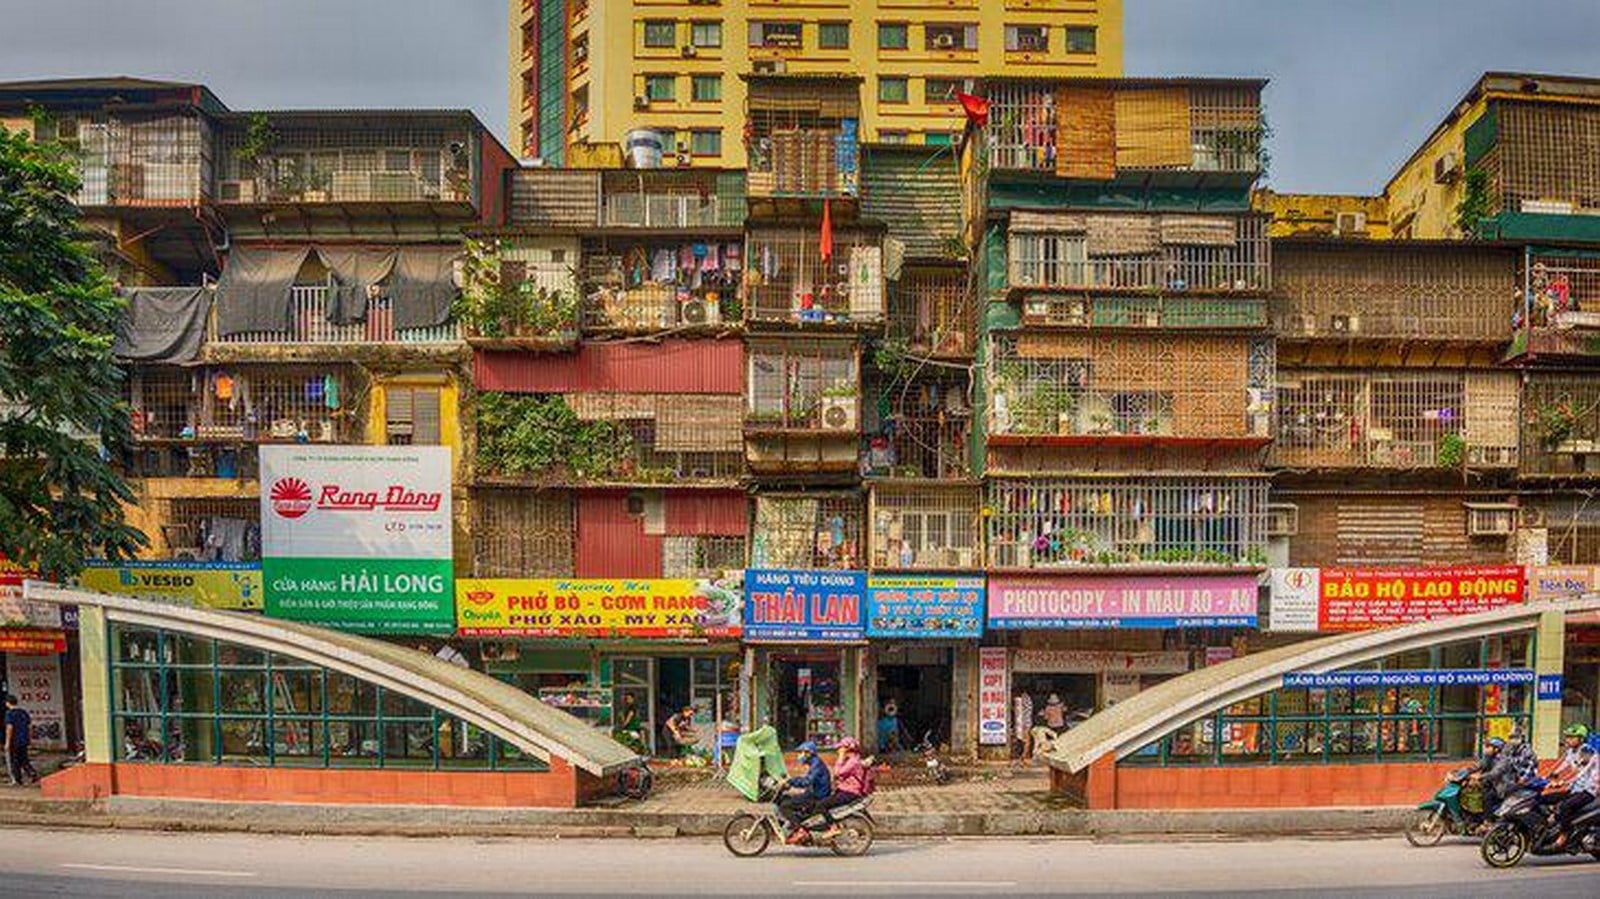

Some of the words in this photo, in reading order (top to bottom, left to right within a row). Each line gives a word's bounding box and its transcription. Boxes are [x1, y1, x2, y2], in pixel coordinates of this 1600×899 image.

[141, 575, 194, 587] VESBO
[272, 576, 298, 591] CỬA
[340, 569, 378, 592] HẢI
[384, 574, 443, 593] LONG
[1324, 575, 1370, 598] BẢO
[1376, 578, 1406, 600] HỘ
[1412, 582, 1452, 597] LAO
[1458, 577, 1517, 596] ĐỘNG
[507, 590, 548, 610] PHỞ
[554, 591, 580, 610] BÒ
[652, 595, 709, 610] RANG
[751, 587, 805, 624] THÁI
[811, 593, 860, 625] LAN
[1002, 589, 1106, 613] PHOTOCOPY
[1121, 589, 1140, 613] IN
[1146, 583, 1185, 613] MÀU
